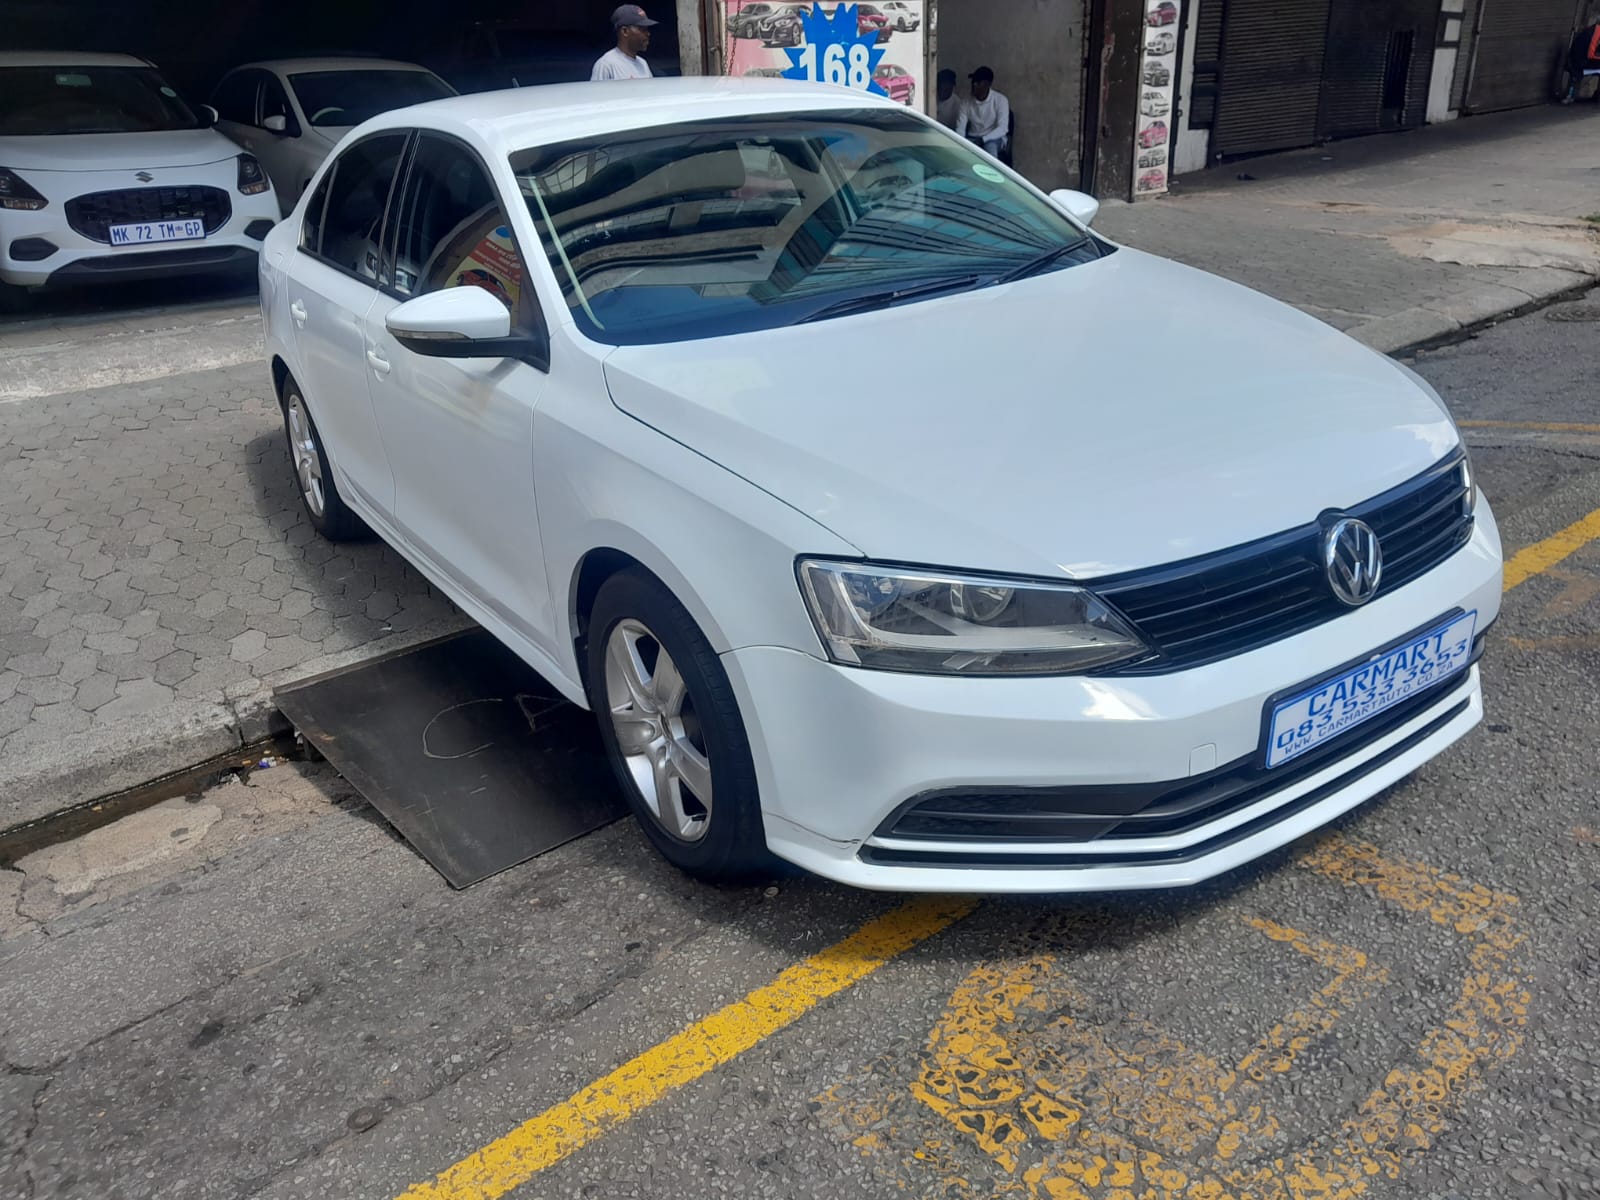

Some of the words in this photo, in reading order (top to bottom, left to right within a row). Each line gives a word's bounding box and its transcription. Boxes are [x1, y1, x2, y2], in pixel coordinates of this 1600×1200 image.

[800, 43, 871, 91] 168
[112, 227, 130, 243] MK
[136, 226, 153, 240] 72
[158, 223, 176, 239] TM
[185, 221, 200, 236] GP
[1277, 710, 1333, 749] 083
[1342, 677, 1395, 716] 533
[1403, 639, 1468, 684] 3653
[1308, 629, 1448, 717] CARMART
